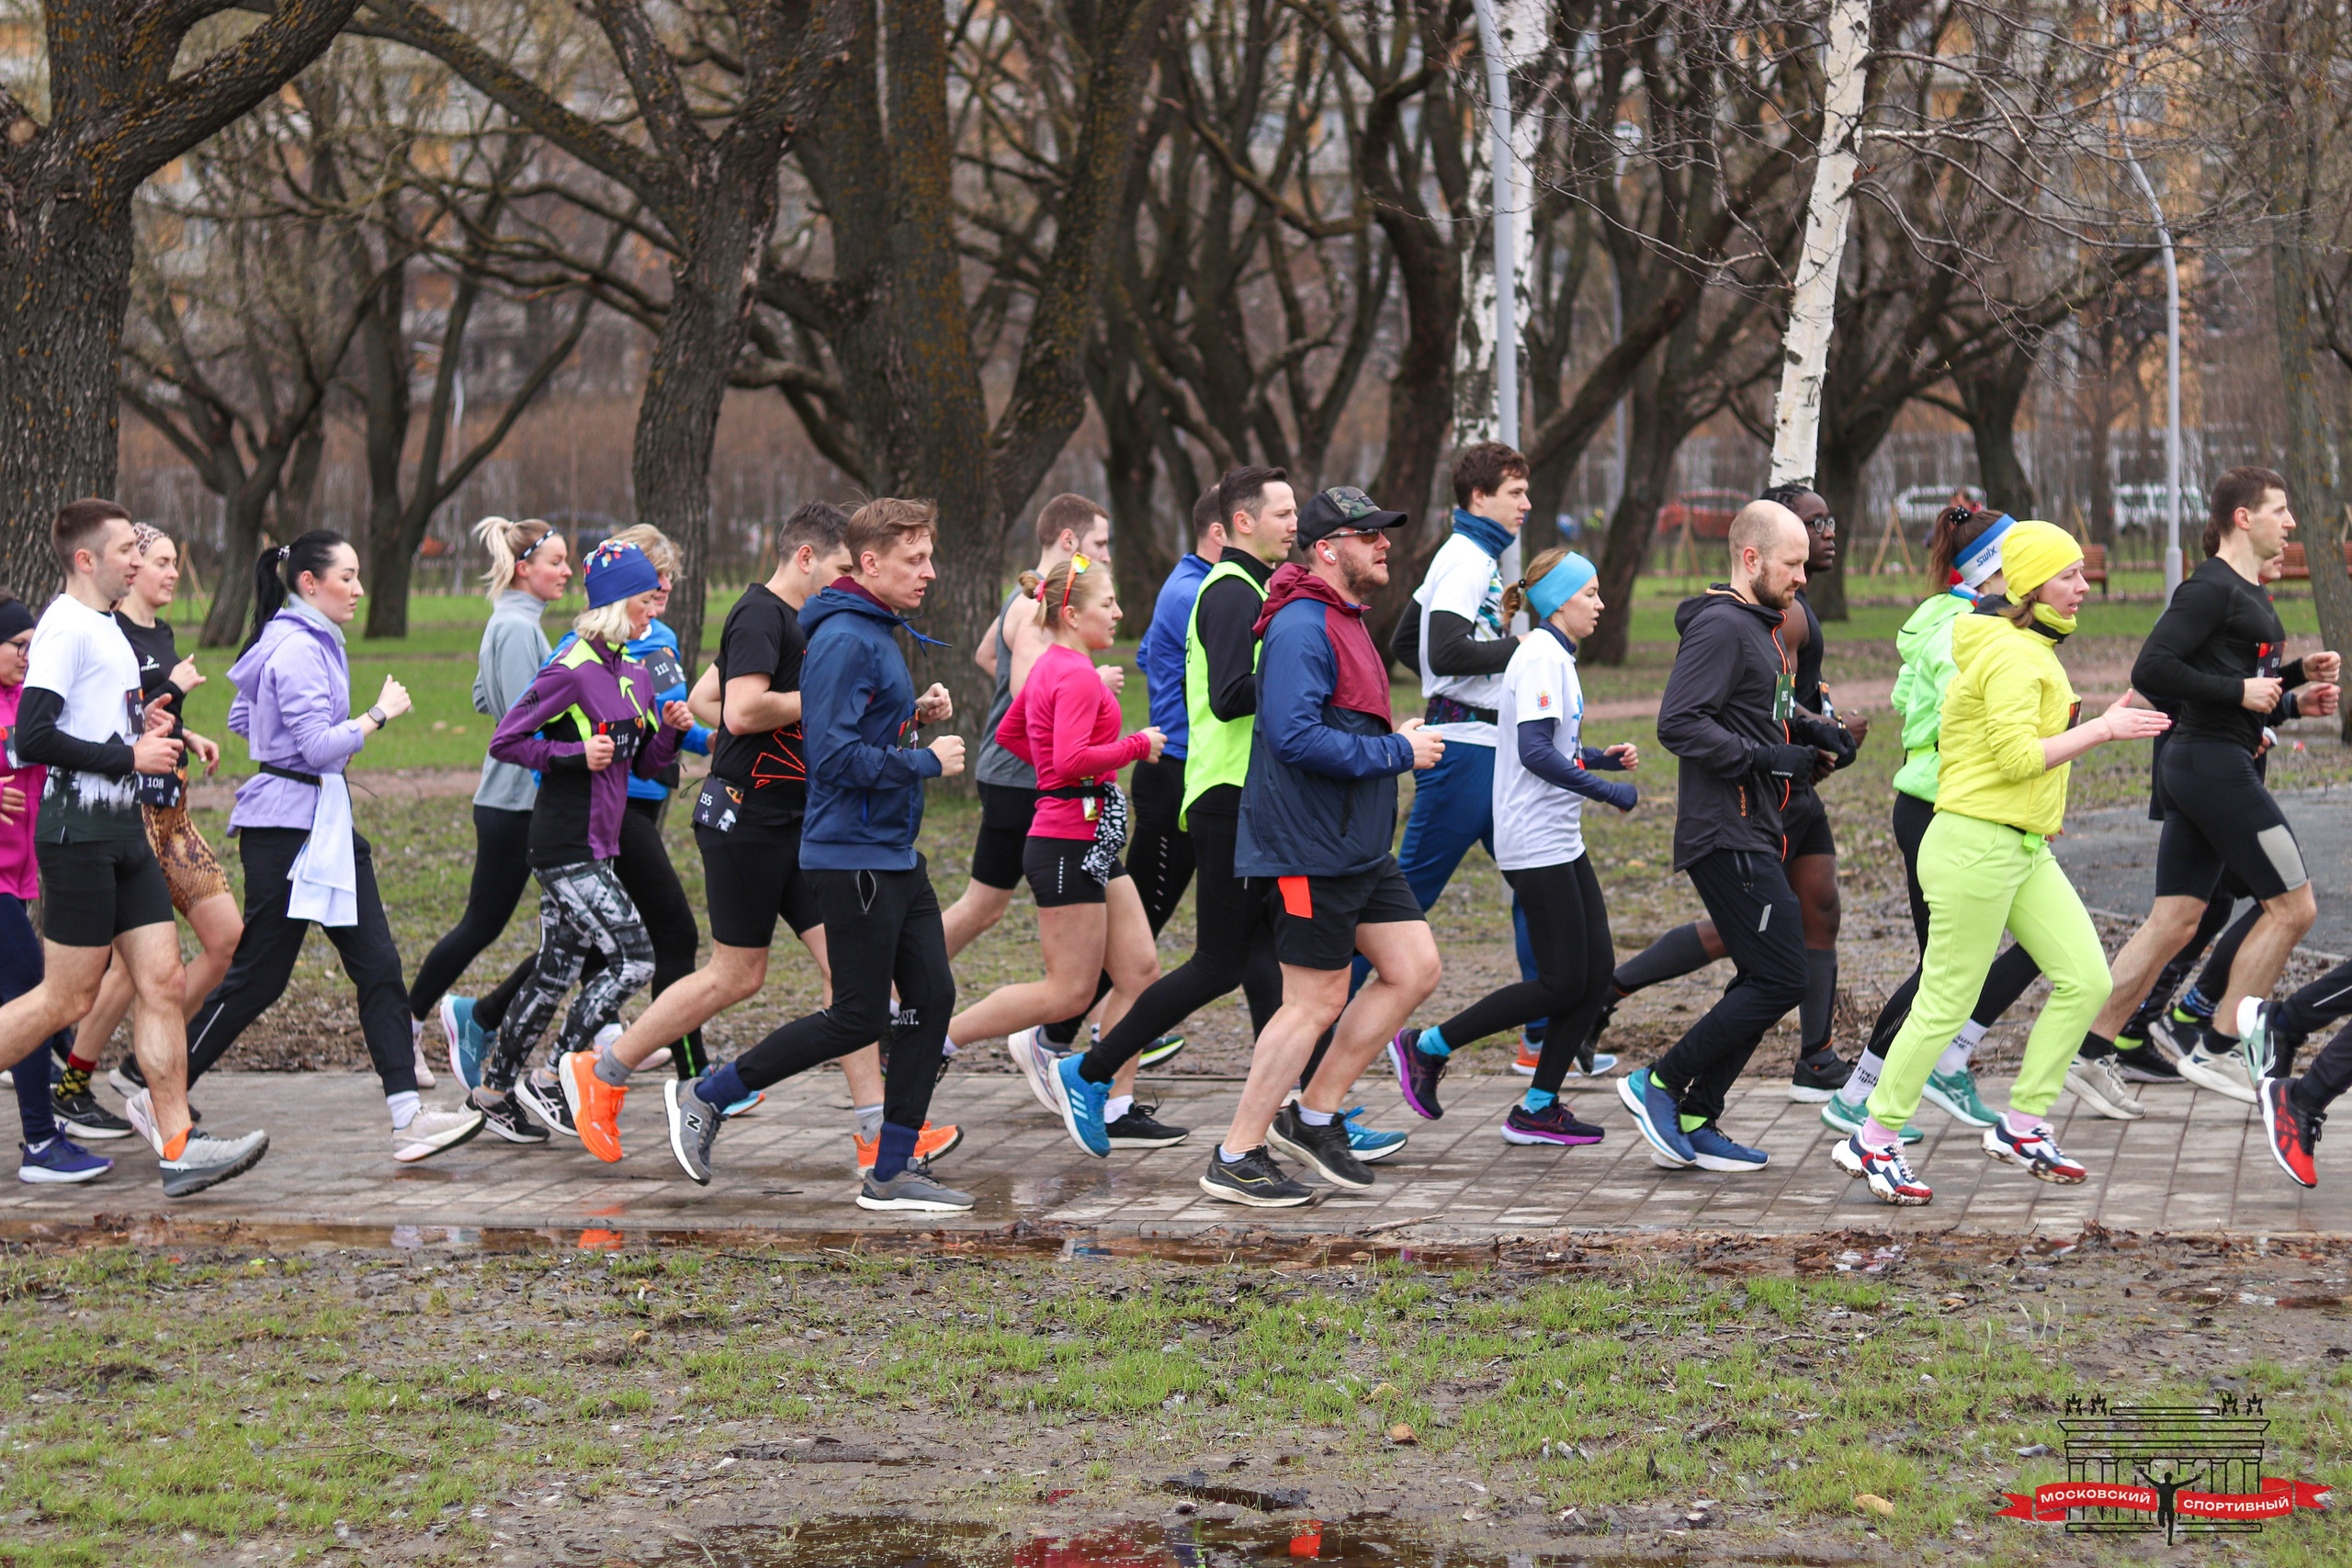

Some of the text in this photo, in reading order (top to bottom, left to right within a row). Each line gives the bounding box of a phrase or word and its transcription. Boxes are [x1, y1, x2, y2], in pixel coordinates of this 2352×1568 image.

[1976, 546, 1997, 568] swix
[654, 662, 670, 676] 111
[616, 733, 629, 746] 116
[146, 776, 165, 790] 108
[700, 792, 713, 807] 155
